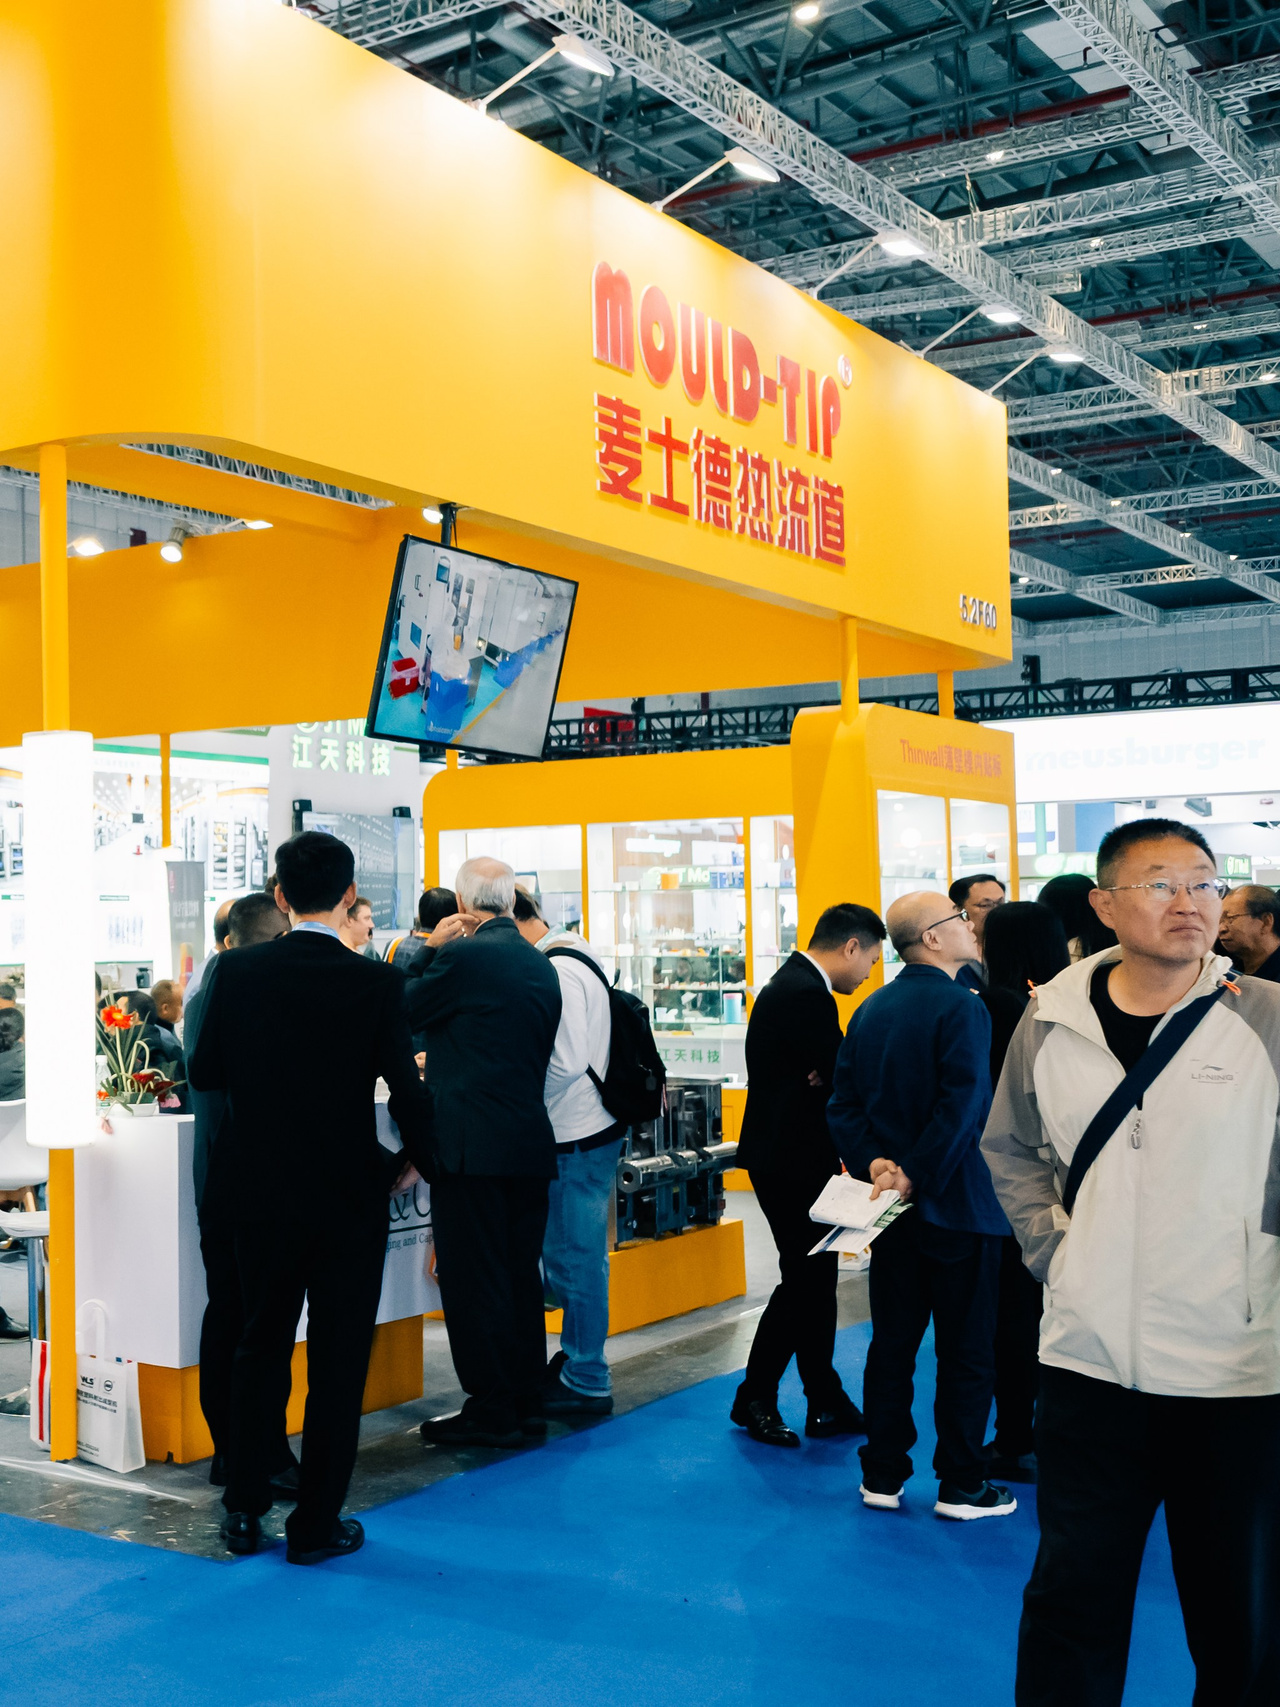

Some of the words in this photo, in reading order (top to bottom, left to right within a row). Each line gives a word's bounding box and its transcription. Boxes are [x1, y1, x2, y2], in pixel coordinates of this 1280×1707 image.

[592, 261, 841, 460] MOULD-TIP
[594, 391, 846, 567] 麦士德热流道
[959, 593, 997, 630] 5.2F60
[291, 733, 391, 776] 江天科技
[1025, 737, 1266, 771] meusburger
[403, 1234, 417, 1247] and
[419, 1232, 433, 1245] Cap
